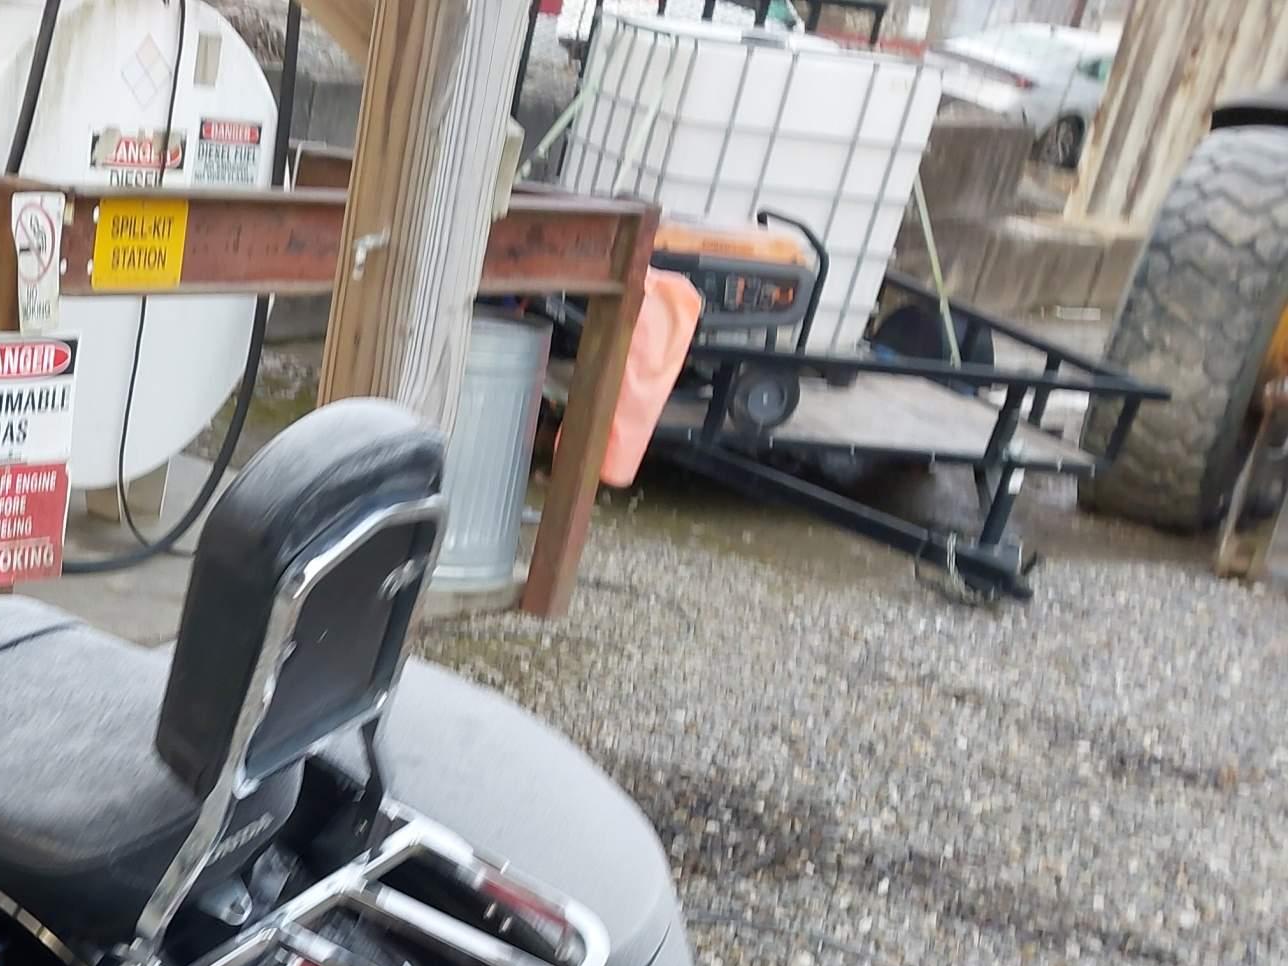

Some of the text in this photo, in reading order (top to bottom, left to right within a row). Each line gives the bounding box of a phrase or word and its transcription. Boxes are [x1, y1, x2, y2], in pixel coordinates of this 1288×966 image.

[111, 214, 175, 239] SPILL-KIT
[111, 245, 167, 271] STATION
[16, 470, 57, 495] ENGINE
